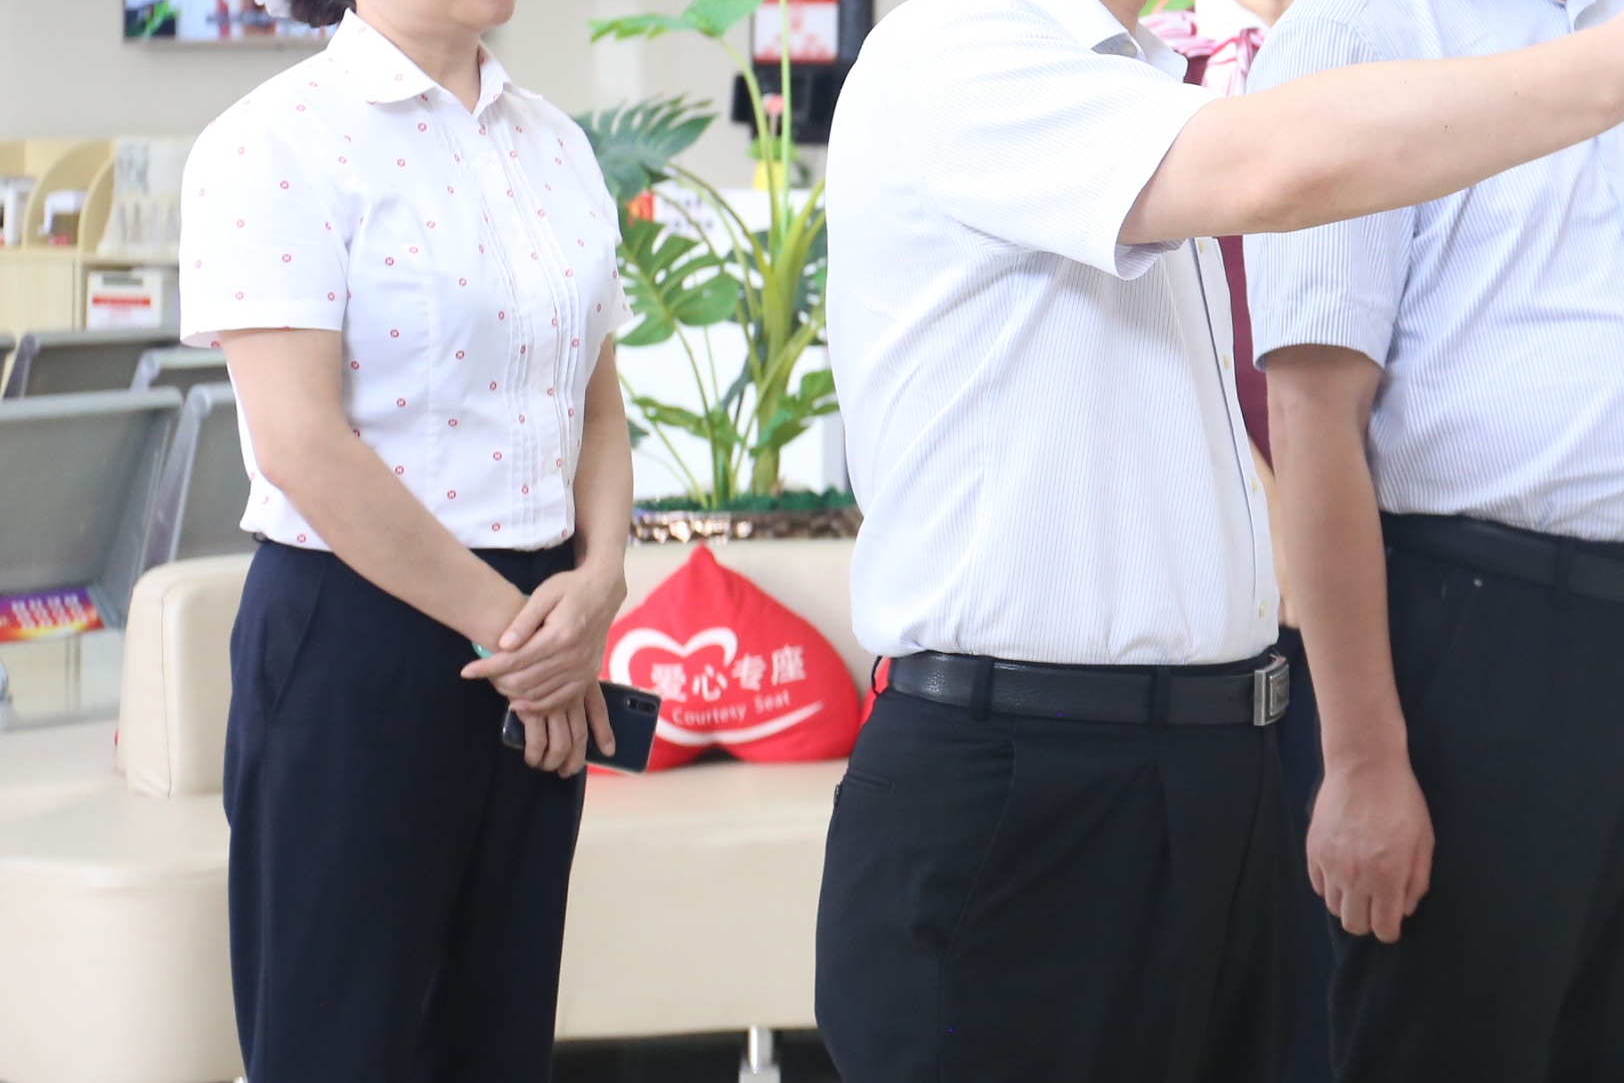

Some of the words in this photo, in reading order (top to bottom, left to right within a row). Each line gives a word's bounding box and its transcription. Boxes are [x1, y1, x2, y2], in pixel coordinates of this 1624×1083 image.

[650, 644, 806, 703] 爱心专座
[672, 704, 747, 727] Courtesy
[754, 689, 790, 714] Seat
